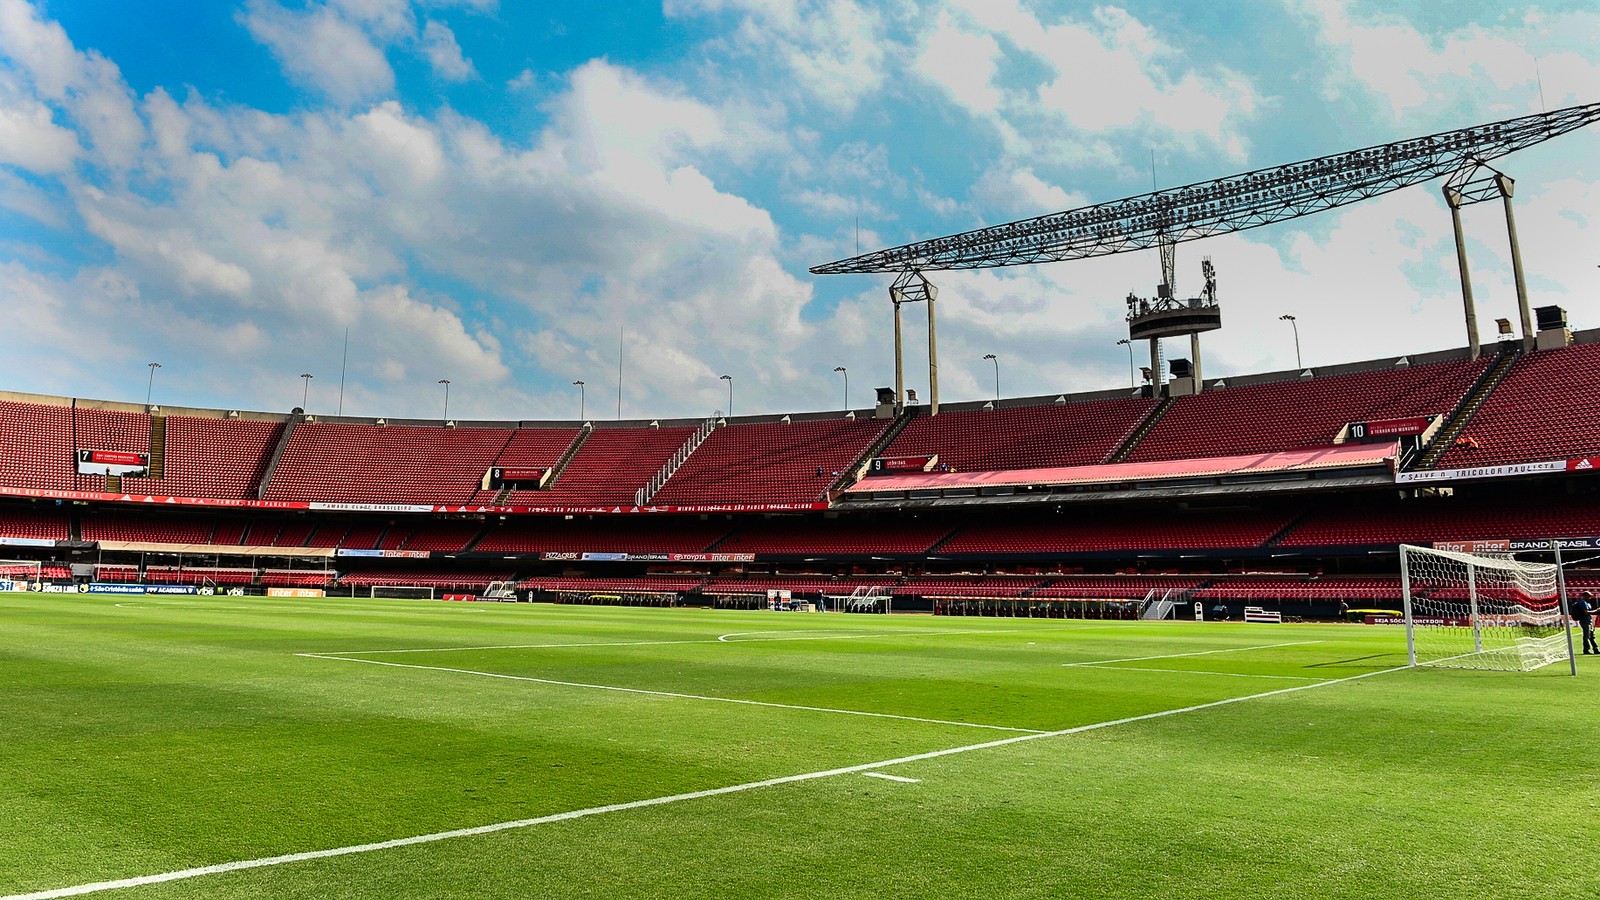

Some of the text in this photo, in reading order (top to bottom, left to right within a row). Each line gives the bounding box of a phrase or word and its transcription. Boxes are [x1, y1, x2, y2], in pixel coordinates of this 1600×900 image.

[1351, 425, 1364, 438] 10
[82, 451, 89, 461] 7
[875, 460, 881, 470] 9
[494, 469, 500, 478] 8
[1456, 468, 1503, 478] TRICOLOR
[1508, 463, 1555, 474] PAULISTA
